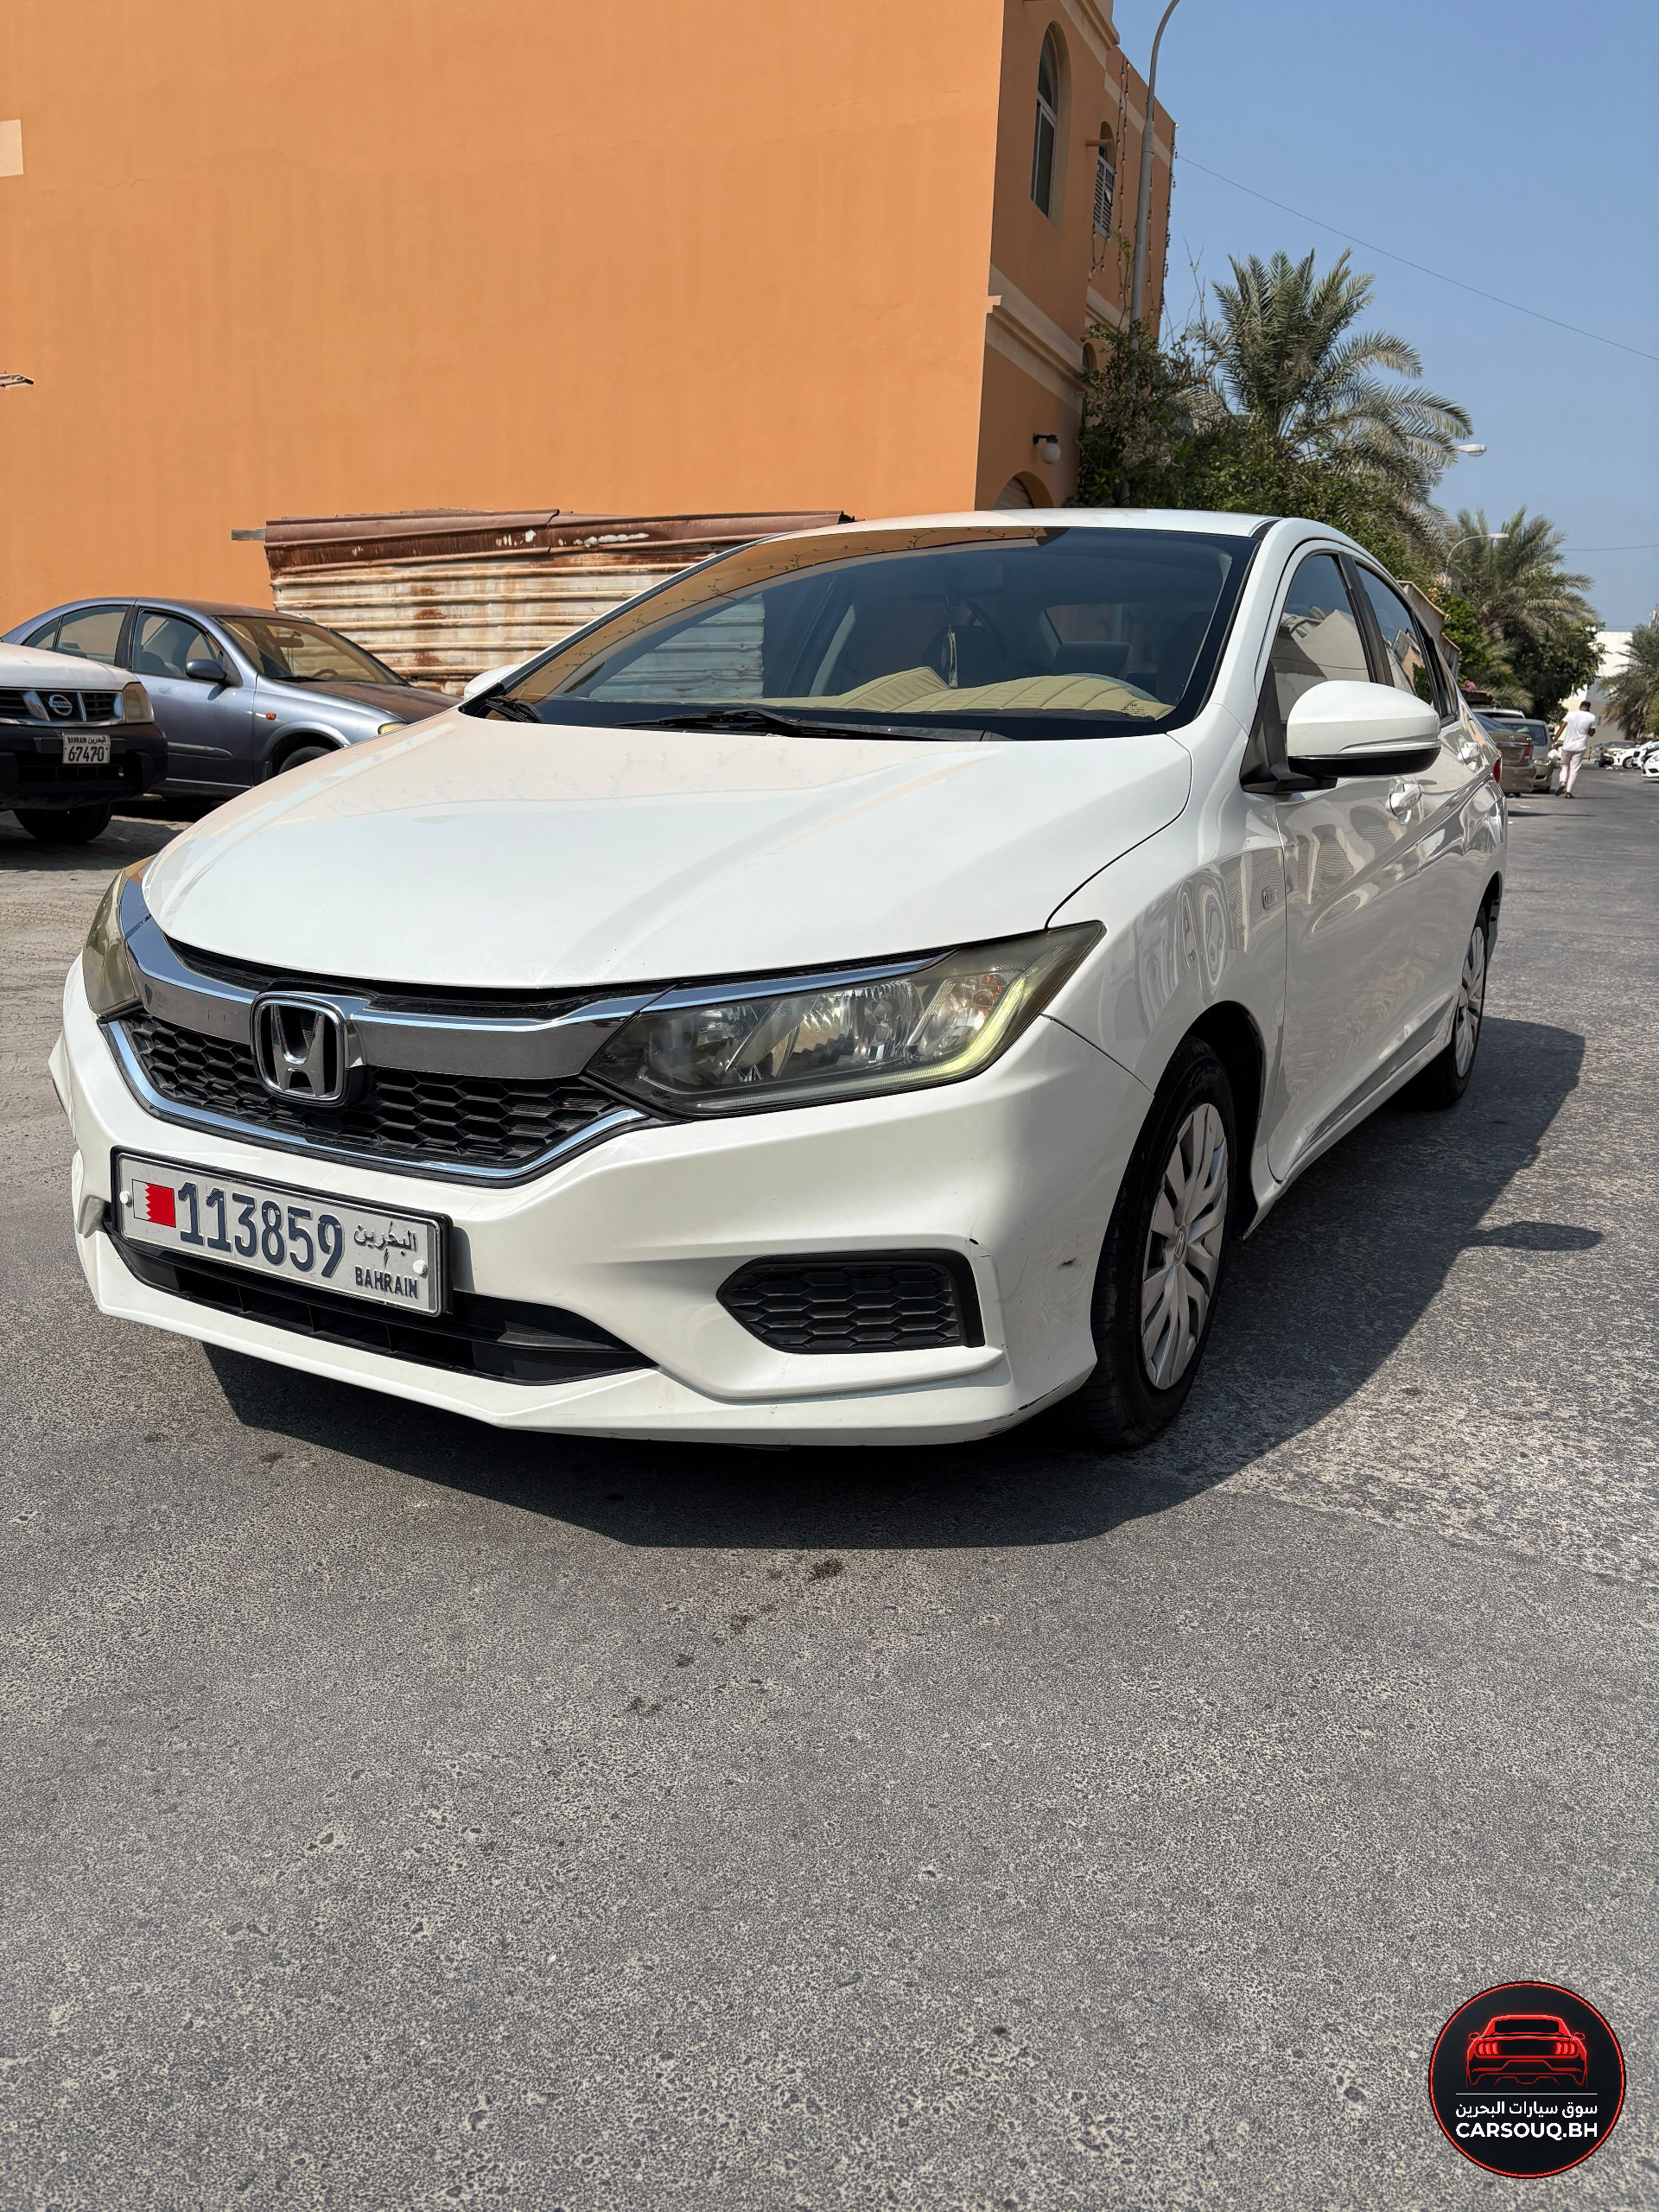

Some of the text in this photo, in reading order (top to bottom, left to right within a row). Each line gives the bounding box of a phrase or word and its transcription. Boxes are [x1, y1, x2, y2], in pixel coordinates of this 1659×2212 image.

[68, 746, 105, 762] 67470
[177, 1181, 345, 1279] 113859
[353, 1224, 418, 1257] البحرين
[354, 1264, 419, 1300] BAHRAIN
